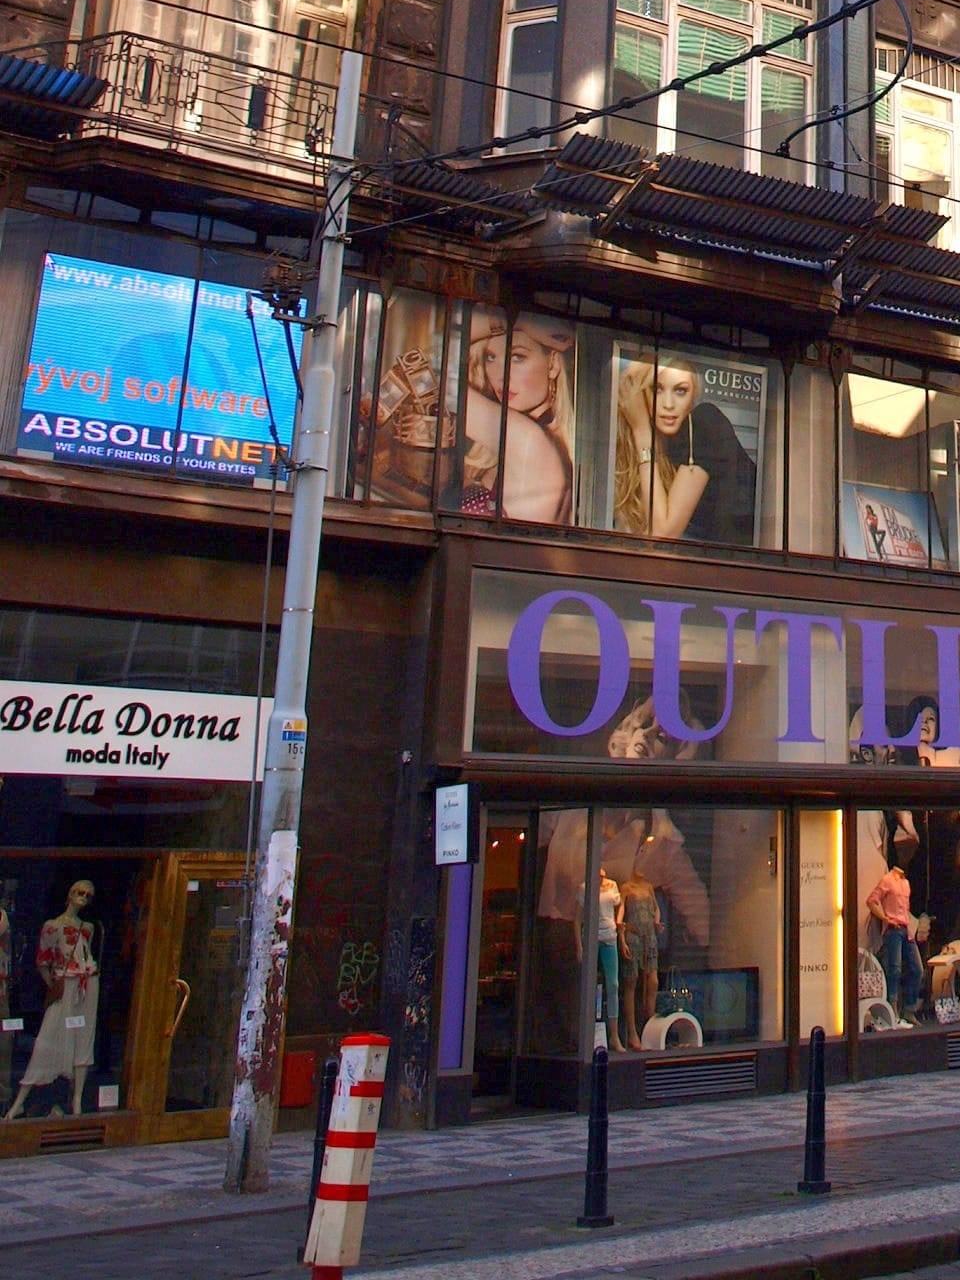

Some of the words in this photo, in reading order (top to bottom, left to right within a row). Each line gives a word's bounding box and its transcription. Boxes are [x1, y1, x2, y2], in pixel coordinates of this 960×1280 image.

[704, 368, 761, 392] GUESS
[24, 413, 288, 464] ABSOLUTNET
[55, 441, 76, 453] WE
[78, 444, 105, 456] ARE
[106, 447, 161, 464] FRIENDS
[183, 457, 217, 471] YOUR
[218, 462, 257, 475] BYTES
[0, 693, 105, 734] Bella
[115, 701, 242, 742] Donna
[65, 742, 120, 765] moda
[125, 743, 171, 770] Italy
